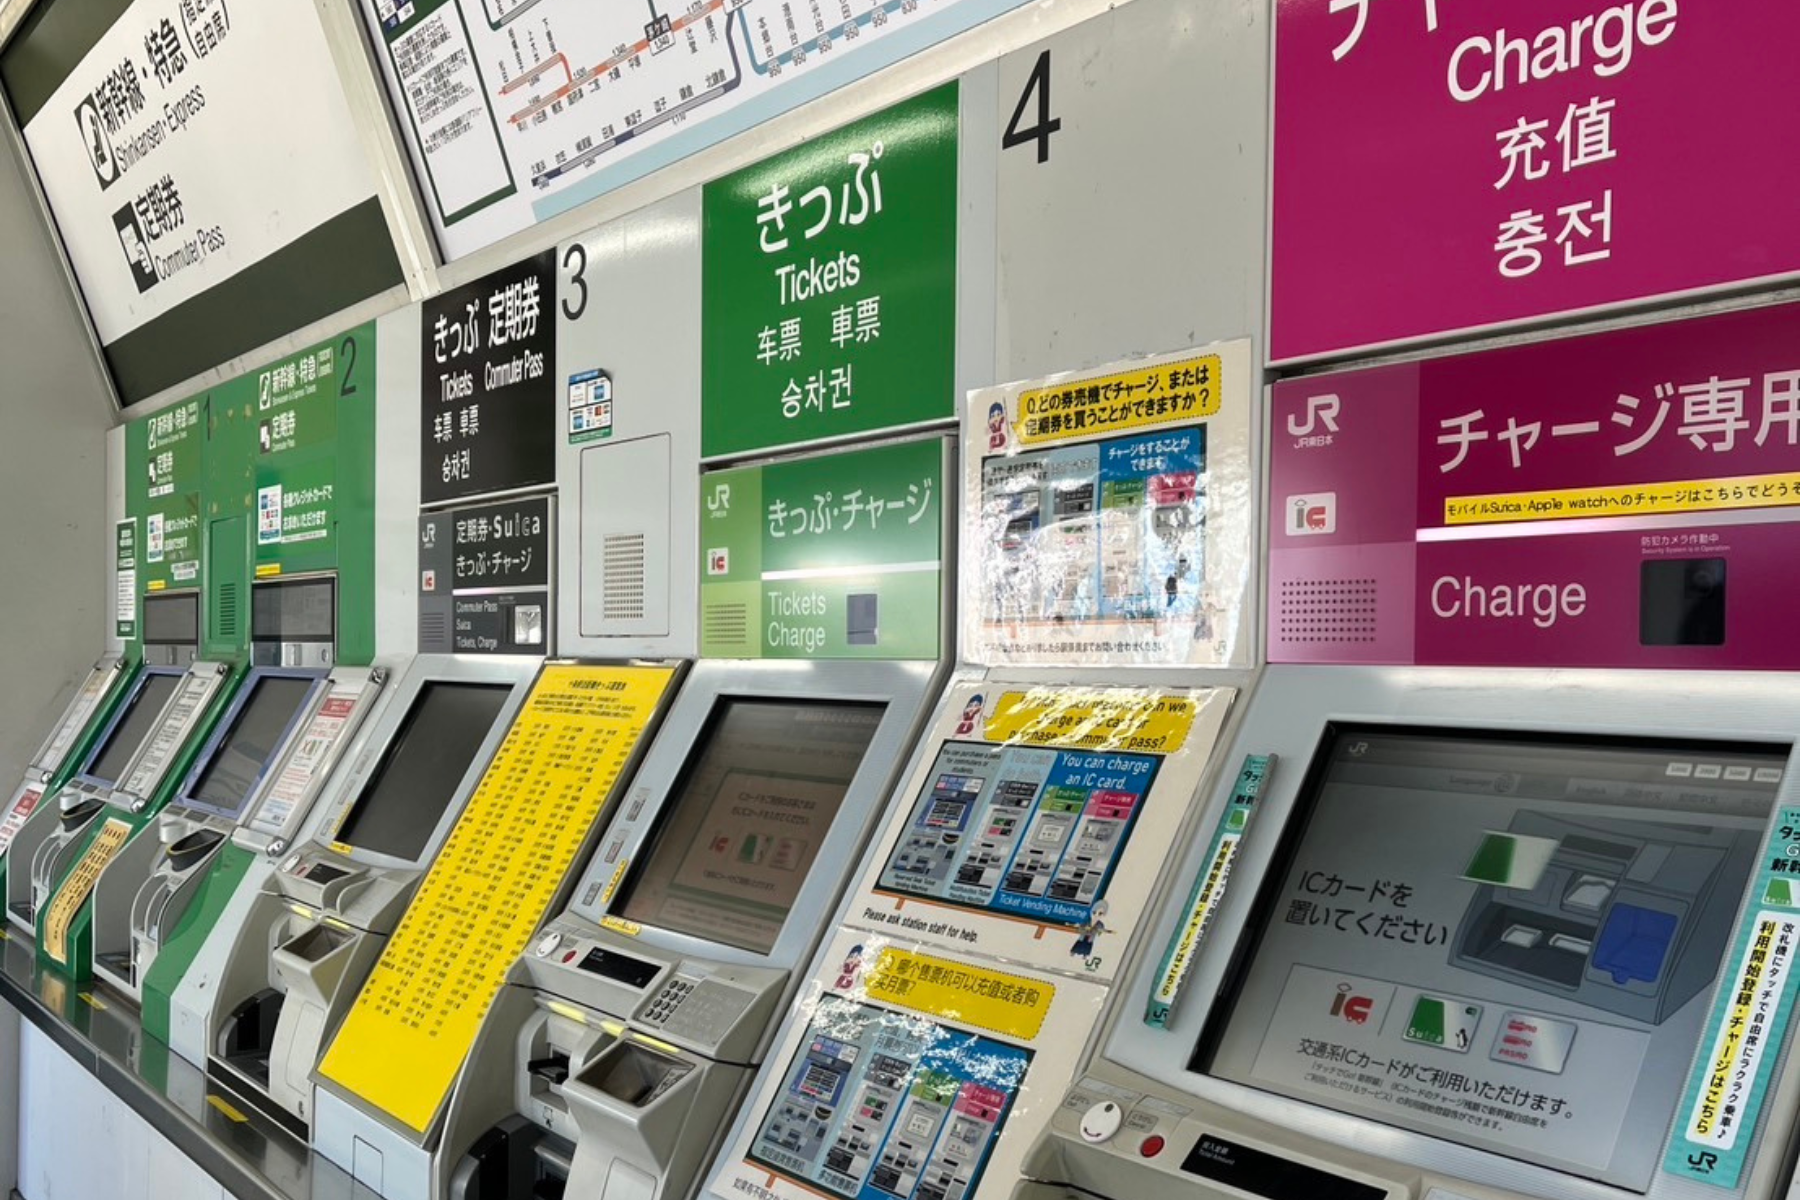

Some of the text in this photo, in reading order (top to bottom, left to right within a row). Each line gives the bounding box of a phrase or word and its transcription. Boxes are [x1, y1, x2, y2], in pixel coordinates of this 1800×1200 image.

[1447, 0, 1678, 102] Charge
[1002, 50, 1062, 164] 4
[1494, 97, 1617, 190] 充值
[135, 174, 185, 243] 定期券
[756, 141, 884, 253] きっぷ
[154, 225, 226, 281] Commuter Pass
[1494, 189, 1612, 278] 충전
[562, 243, 588, 320] 3
[775, 251, 861, 304] Tickets
[434, 275, 540, 364] きっぷ 定期券
[756, 296, 881, 366] 车票 車票
[341, 336, 356, 396] 2
[440, 349, 544, 402] Tickets Commuter Pass
[781, 363, 852, 418] 승차권
[203, 394, 211, 441] 1
[1288, 393, 1341, 436] JR
[1437, 369, 1800, 474] チャージ専用
[442, 447, 470, 482] 승차권
[708, 484, 730, 510] JR
[768, 477, 932, 538] きっぷ・チャージ
[422, 523, 436, 543] JR
[456, 546, 532, 577] きっぷ・チャージ
[456, 601, 484, 613] Commuter
[483, 600, 498, 612] Pass
[768, 591, 826, 616] Tickets
[1431, 576, 1587, 627] Charge
[768, 621, 826, 653] Charge
[1061, 754, 1150, 773] You can charge
[1065, 773, 1127, 790] an IC card.
[1000, 893, 1088, 919] Ticket Vending Machine
[1298, 871, 1413, 908] ICカードを
[862, 907, 979, 943] Please ask station staff for help.
[1285, 899, 1448, 946] 置いてください
[1697, 919, 1777, 1134] 利用開始登録・チャージはこちら
[1298, 1037, 1573, 1120] 交通系ICカードがご利用いただけます。
[1687, 1151, 1718, 1171] JR
